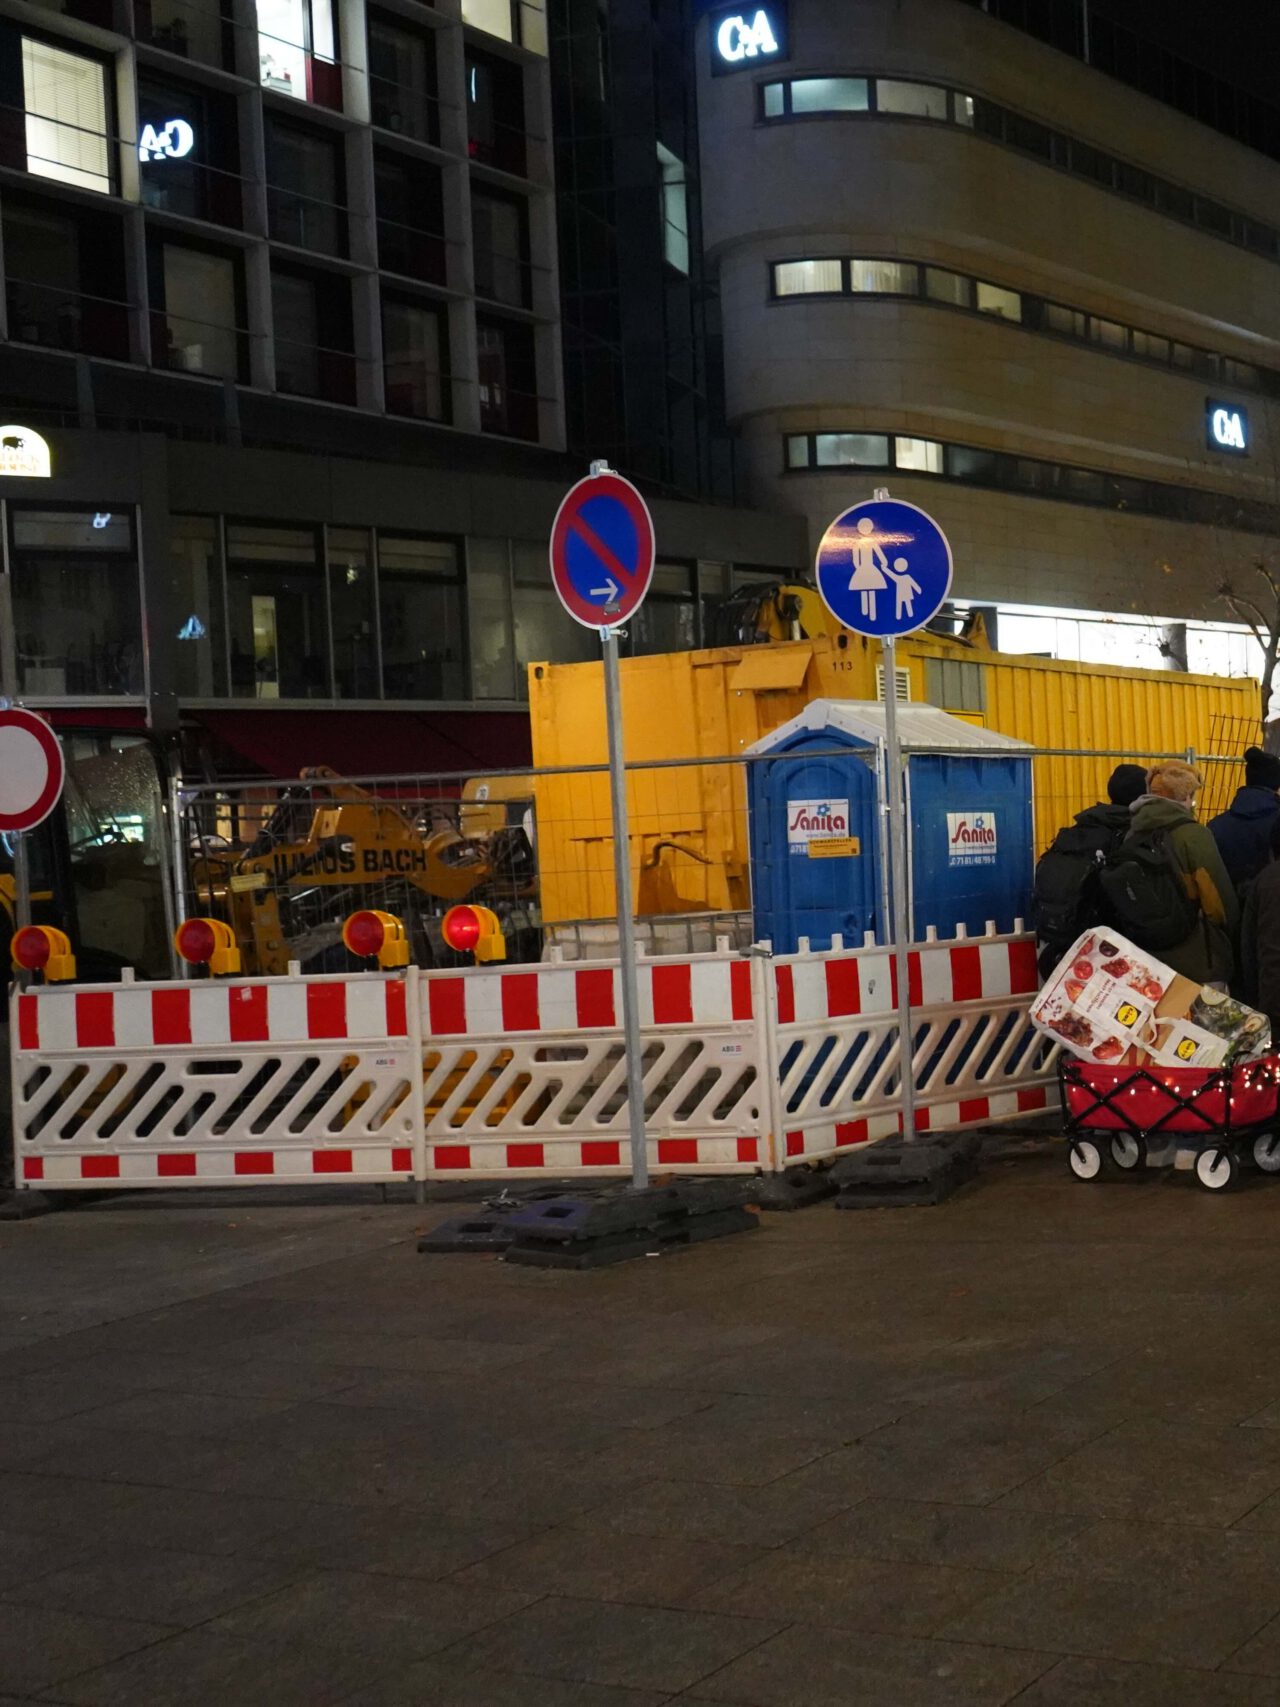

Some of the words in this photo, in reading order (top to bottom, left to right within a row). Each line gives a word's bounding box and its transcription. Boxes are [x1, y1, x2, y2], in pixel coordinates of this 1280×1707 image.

[832, 660, 853, 672] 113
[790, 808, 846, 832] Sanita
[951, 820, 995, 845] Sanita
[362, 848, 427, 872] BACH
